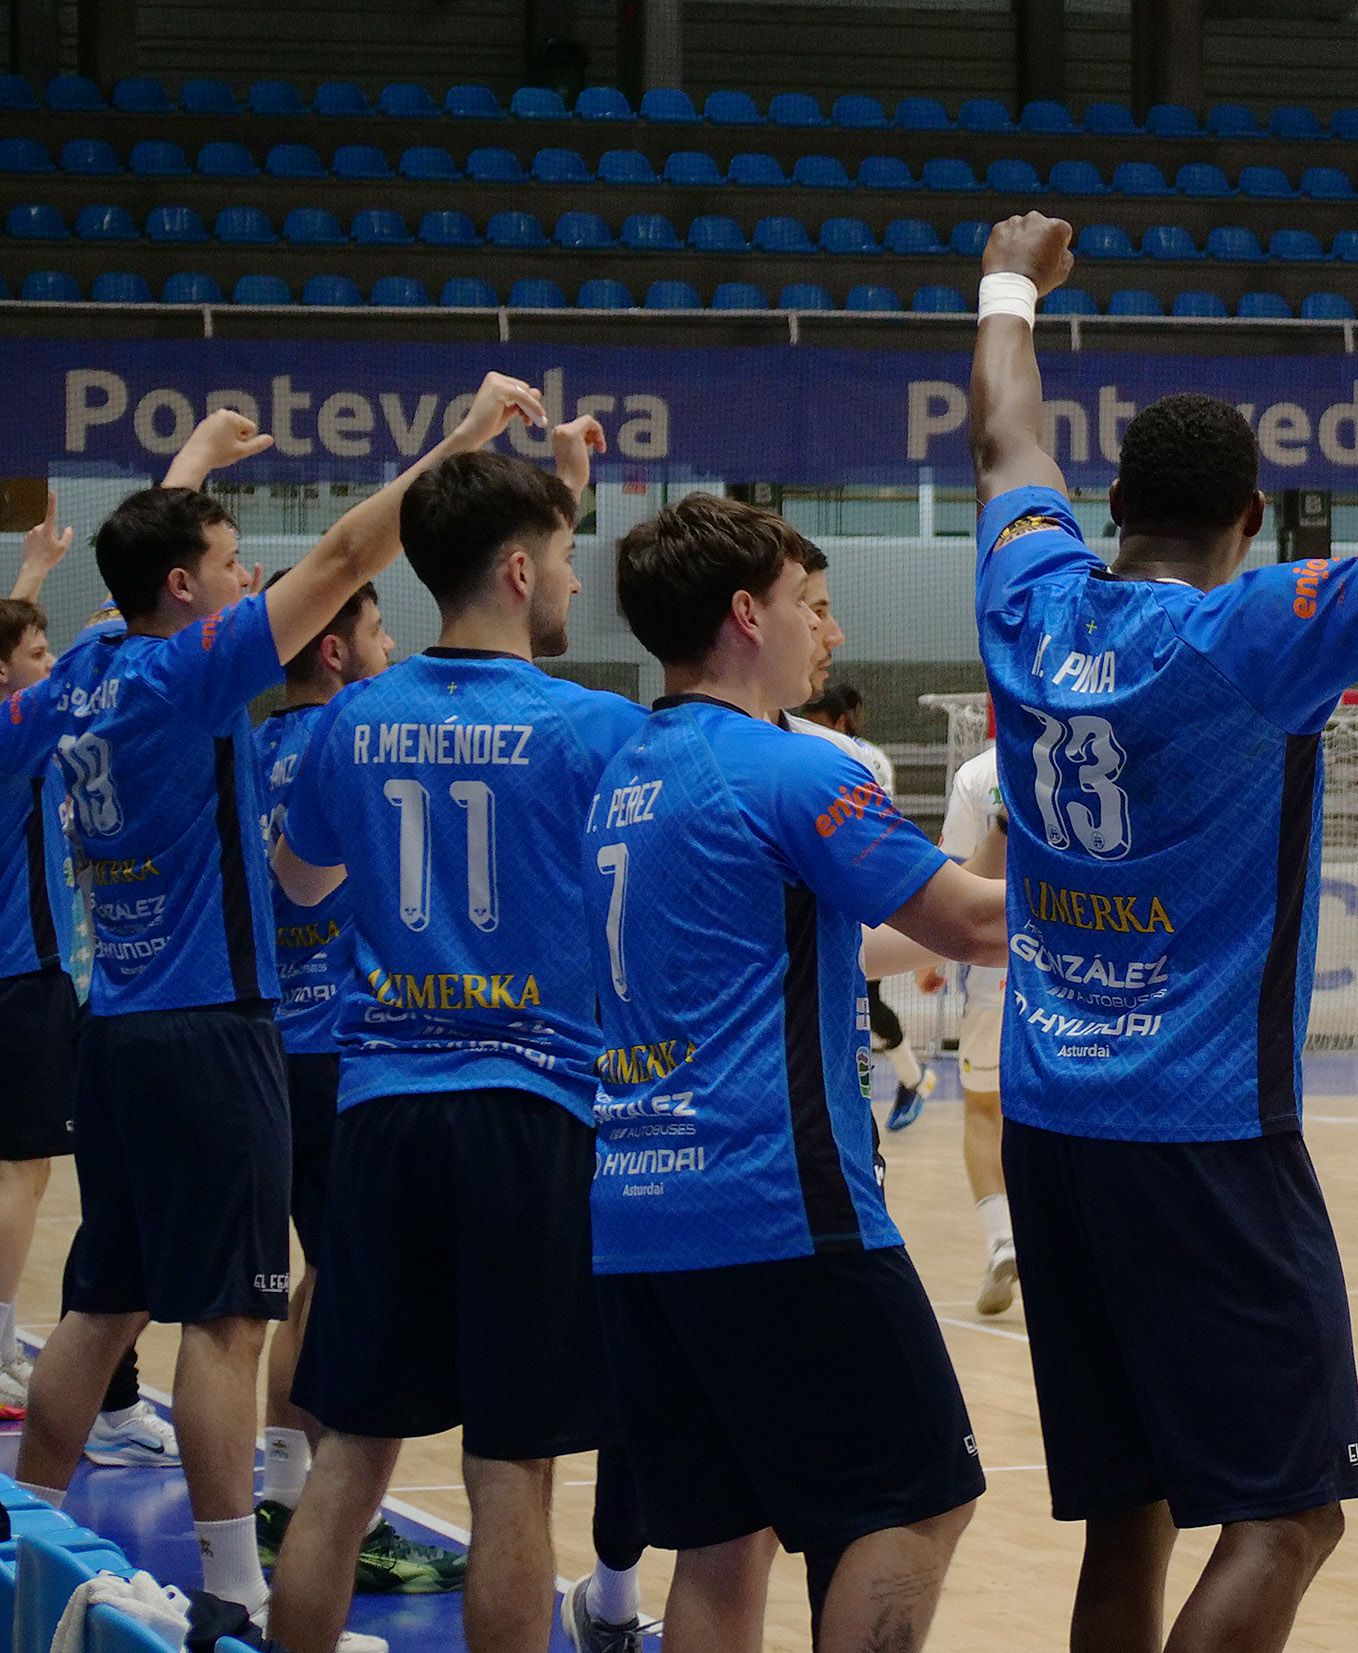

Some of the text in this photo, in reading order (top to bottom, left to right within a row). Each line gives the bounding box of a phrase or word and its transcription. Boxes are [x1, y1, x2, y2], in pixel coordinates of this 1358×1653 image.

[606, 775, 663, 829] PÉREZ
[1021, 704, 1132, 860] 13
[383, 778, 499, 933] 11
[597, 842, 631, 1003] 7
[1010, 932, 1169, 990] GONZÁLEZ
[1057, 1044, 1110, 1058] Asturdai
[627, 1122, 697, 1139] AUTOBUSES
[602, 1146, 705, 1177] HYUNDAI
[622, 1182, 665, 1197] Asturdai
